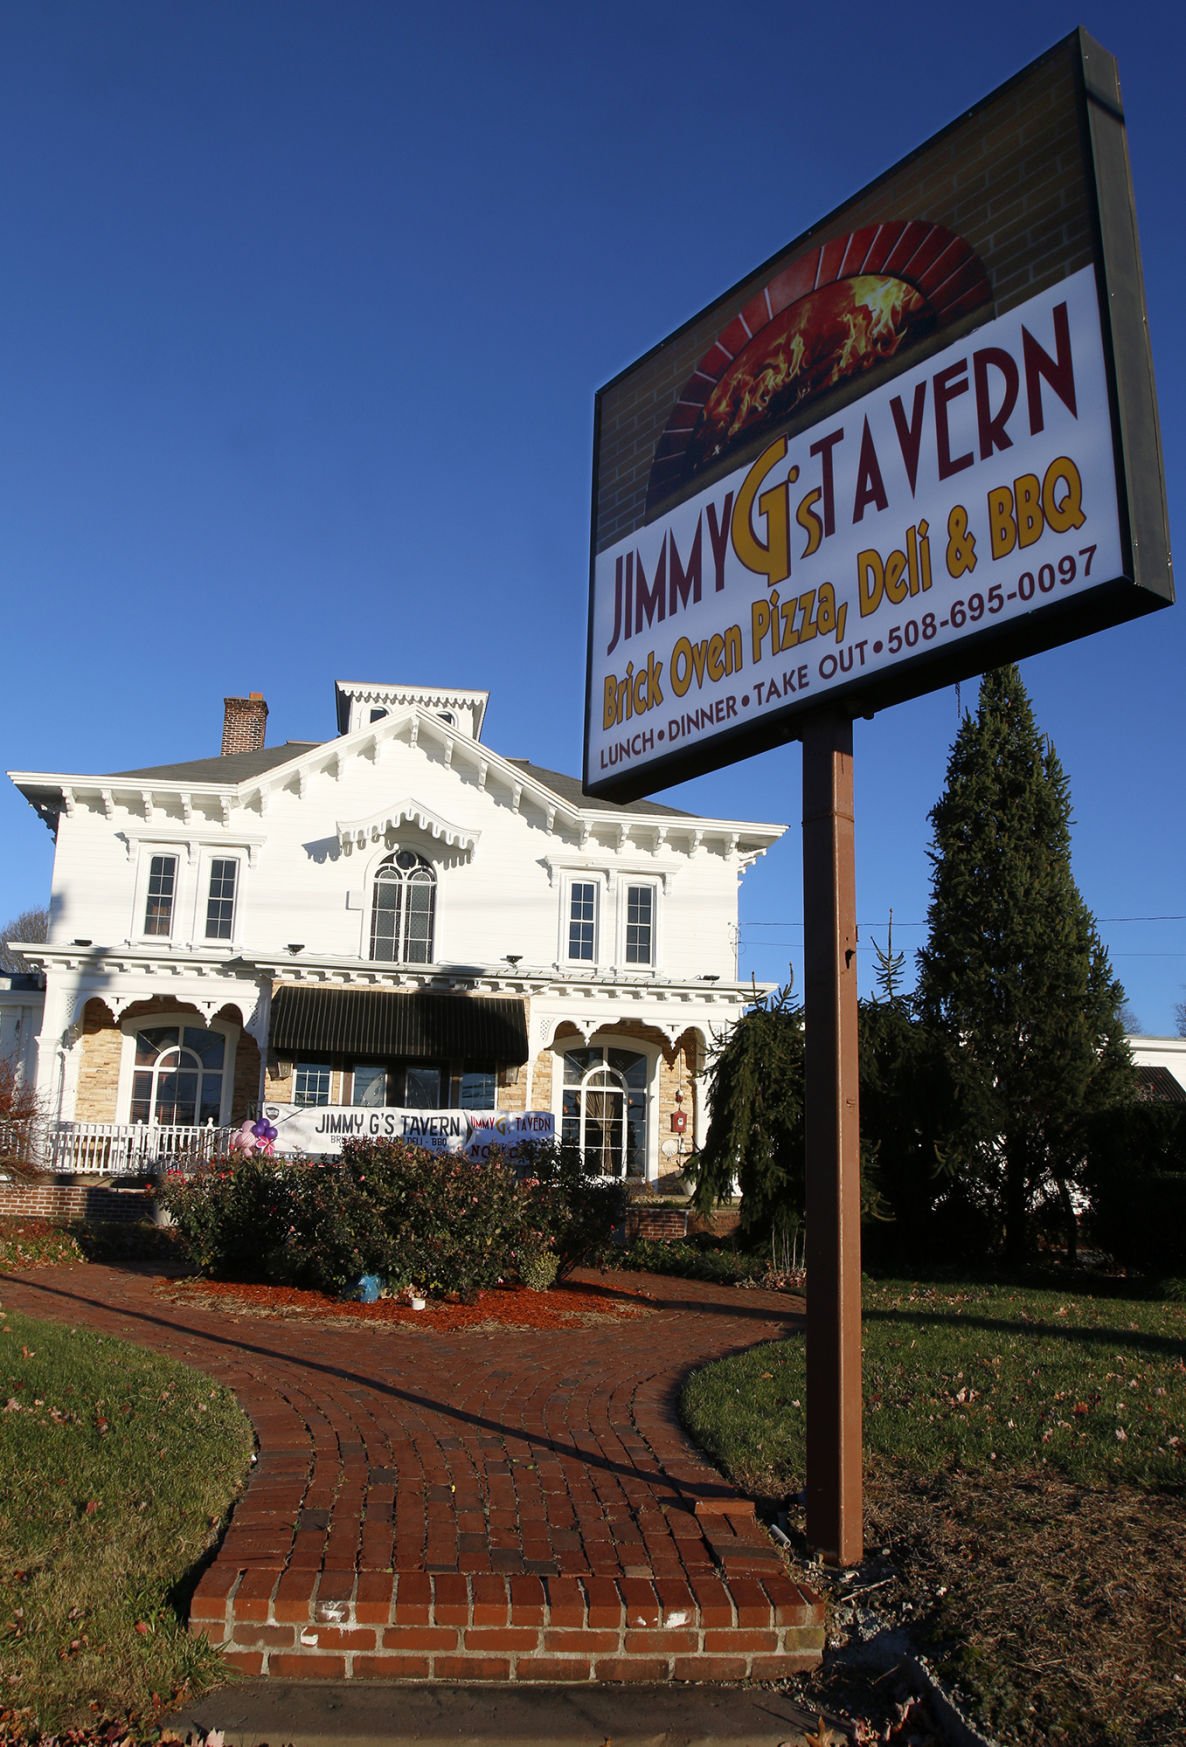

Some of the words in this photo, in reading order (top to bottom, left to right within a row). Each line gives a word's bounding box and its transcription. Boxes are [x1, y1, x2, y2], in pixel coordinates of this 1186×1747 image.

[607, 490, 734, 657] JIMMY
[810, 301, 1079, 538] TAVERN
[603, 650, 664, 731] Brick
[670, 624, 743, 698] Oven
[752, 582, 848, 664] Pizza,
[857, 518, 933, 618] Deli
[945, 505, 978, 579] &
[987, 456, 1087, 561] BBQ
[600, 728, 655, 769] LUNCH
[668, 695, 738, 742] DINNER
[753, 664, 810, 706] TAKE
[818, 640, 868, 680] OUT
[887, 544, 1098, 654] 508-695-0097
[315, 1113, 364, 1134] JIMMY
[369, 1113, 395, 1135] G'S
[401, 1115, 460, 1137] TAVERN
[431, 1137, 447, 1147] BBQ
[515, 1117, 551, 1131] TAVERN
